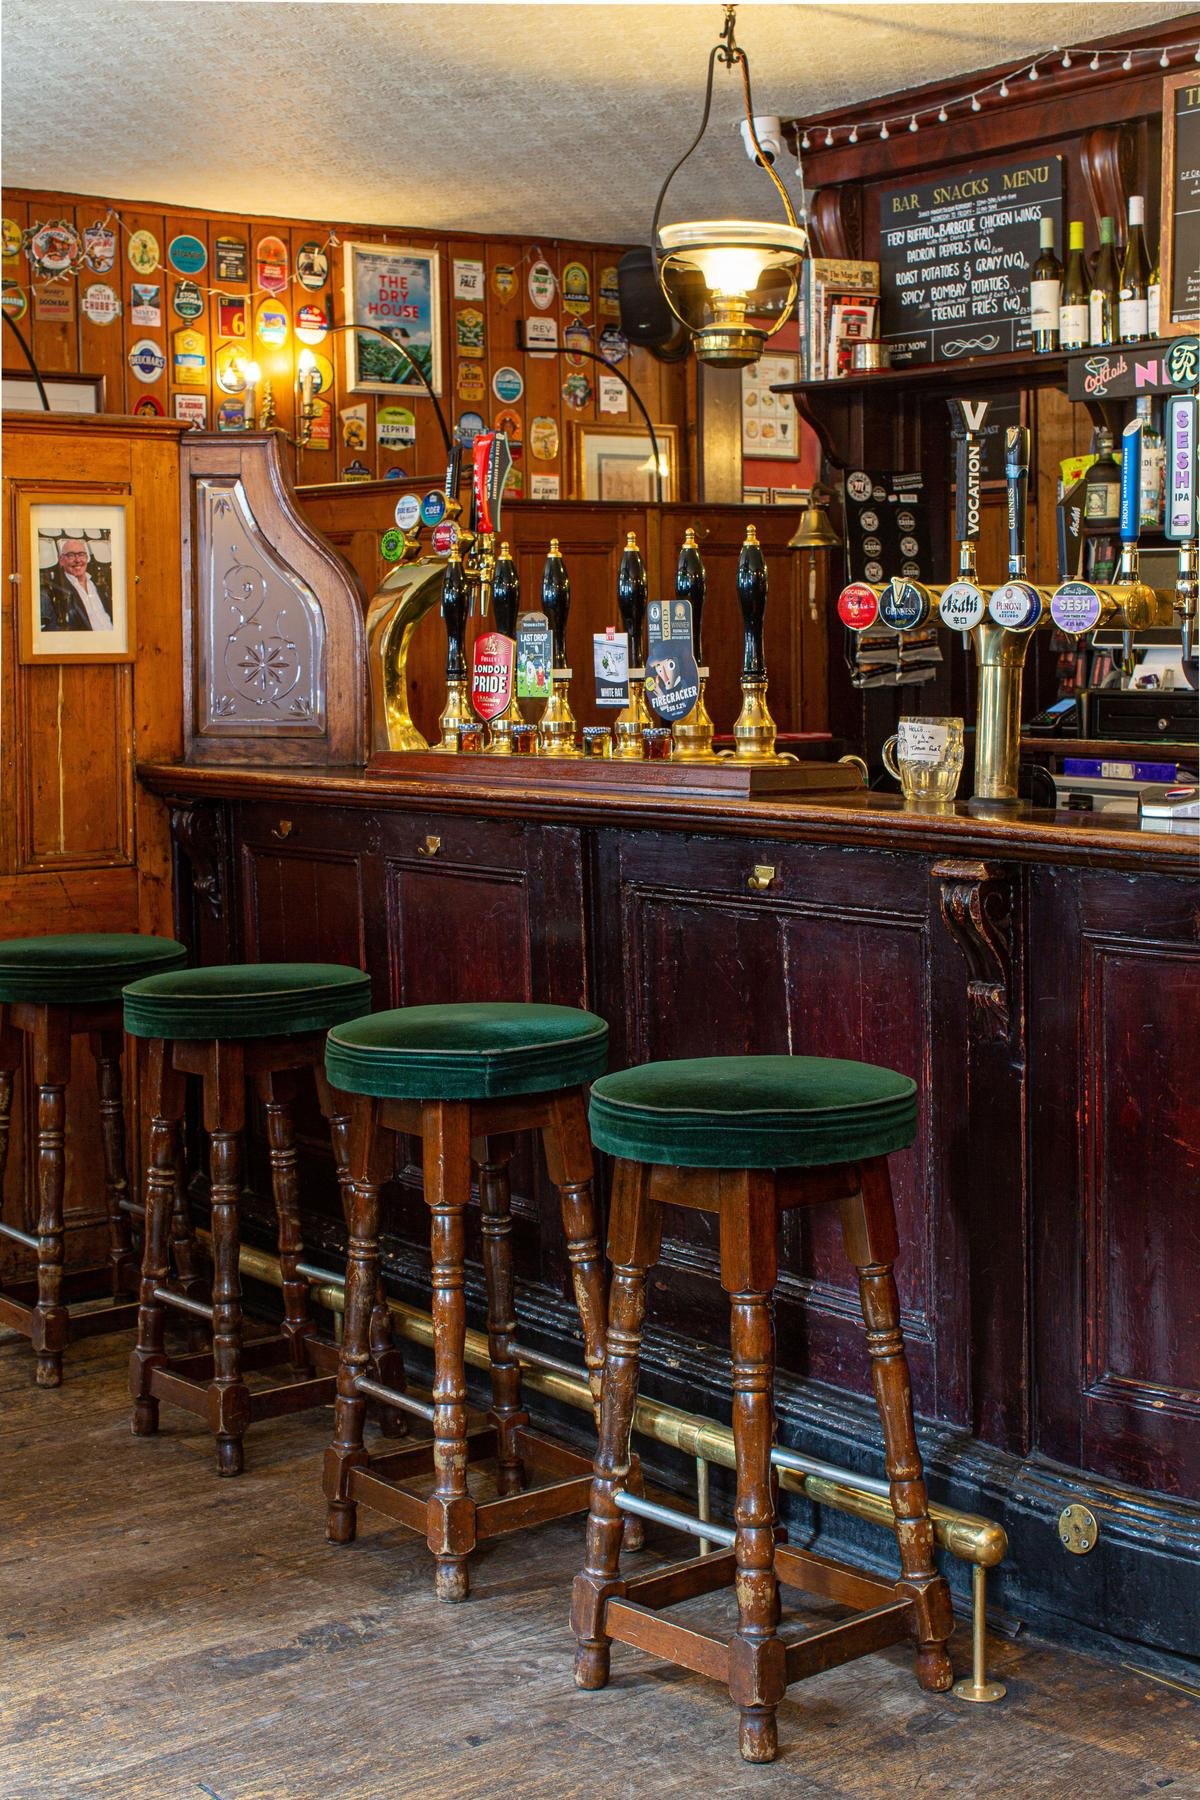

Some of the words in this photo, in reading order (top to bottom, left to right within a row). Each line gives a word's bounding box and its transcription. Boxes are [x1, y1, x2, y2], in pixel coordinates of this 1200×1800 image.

[892, 194, 920, 213] BAR
[933, 178, 989, 205] SNACKS
[1002, 166, 1049, 190] MENU
[887, 231, 904, 247] FIERY
[907, 226, 934, 243] BUFFALO
[939, 217, 975, 237] BARBECUE
[980, 211, 1012, 230] CHICKEN
[1015, 206, 1042, 221] WINGS
[906, 247, 936, 264] PADRON
[939, 241, 971, 257] PEPPERS
[974, 237, 991, 254] (VG)
[896, 271, 918, 287] ROAST
[922, 263, 960, 282] POTATOES
[976, 255, 1002, 272] GRAVY
[1003, 251, 1025, 270] (VG)
[379, 275, 408, 290] THE
[460, 279, 477, 289] PALE
[901, 290, 925, 306] SPICY
[931, 282, 967, 301] BOMBAY
[971, 275, 1010, 294] POTATOES
[379, 289, 409, 304] DRY
[368, 302, 420, 319] HOUSE
[931, 304, 966, 322] FRENCH
[972, 300, 998, 316] FRIES
[1003, 296, 1021, 313] (VG)
[232, 312, 246, 336] 6
[532, 325, 553, 334] REV
[130, 355, 164, 369] DEUCHARS
[1084, 355, 1128, 393] Cocktails
[961, 400, 988, 431] V
[381, 425, 410, 433] ZEPHYR
[1176, 410, 1190, 489] SESH
[967, 446, 980, 536] VOCATION
[1175, 493, 1190, 502] IPA
[425, 506, 440, 515] CIDER
[1121, 500, 1129, 529] PERONI
[885, 606, 916, 616] GUINNESS
[942, 594, 979, 614] Asahi
[996, 601, 1022, 611] PERONI
[1059, 599, 1091, 612] SESH
[671, 621, 690, 629] WINNER
[520, 633, 534, 642] LAST
[534, 633, 548, 642] DROP
[474, 664, 509, 675] LONDON
[473, 676, 507, 694] PRIDE
[601, 688, 614, 698] WHITE
[614, 688, 623, 697] RAT
[651, 685, 698, 709] FIRECRACKER
